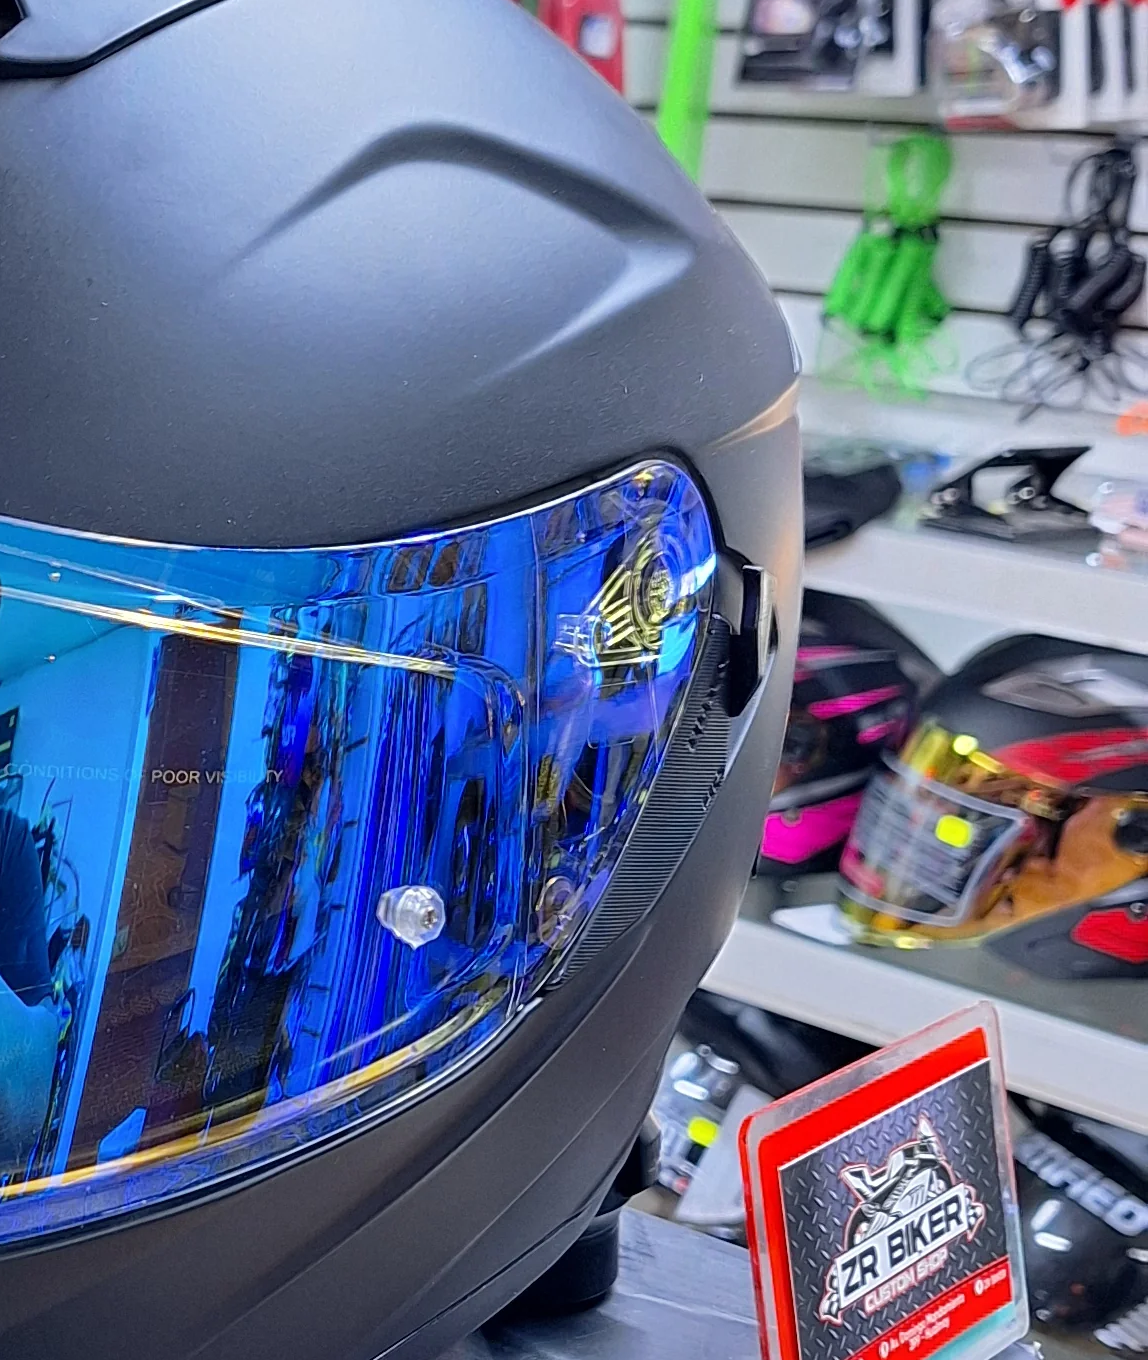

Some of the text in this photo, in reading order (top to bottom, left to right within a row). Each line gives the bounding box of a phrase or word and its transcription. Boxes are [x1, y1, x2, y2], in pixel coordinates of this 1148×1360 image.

[4, 762, 120, 782] CONDITIONS
[151, 769, 201, 784] POOR
[841, 1194, 964, 1297] ZR BIKER
[864, 1248, 948, 1315] CUSTOM SHOP
